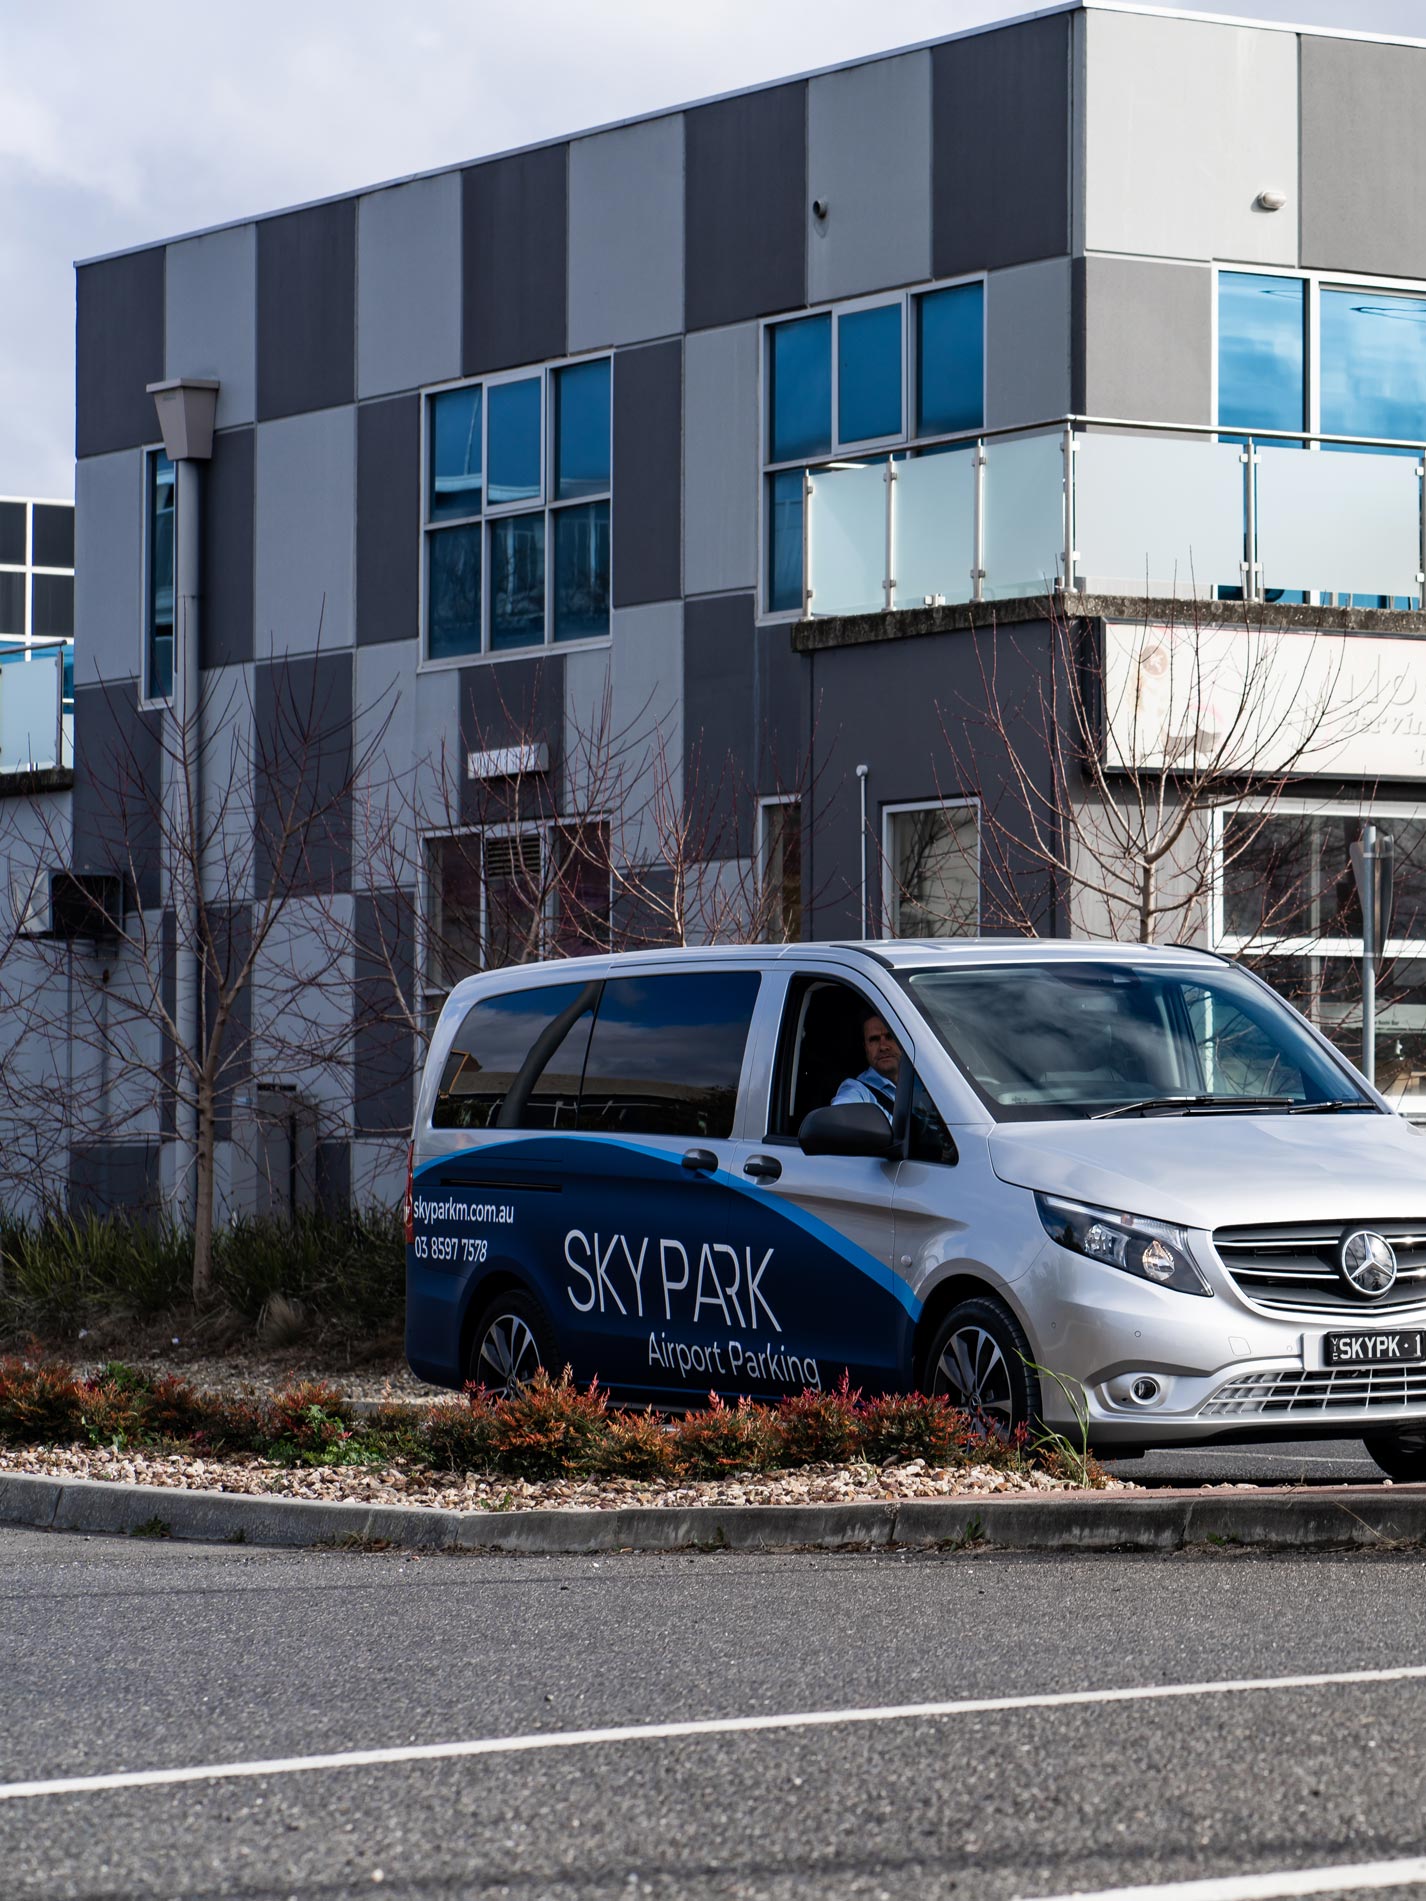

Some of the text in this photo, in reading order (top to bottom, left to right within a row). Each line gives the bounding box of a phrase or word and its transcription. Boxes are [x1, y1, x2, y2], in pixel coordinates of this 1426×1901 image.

[413, 1195, 515, 1225] skyparkm.com.au
[414, 1235, 488, 1263] 03 8597 7578
[648, 1330, 822, 1393] Airport Parking
[1340, 1335, 1400, 1359] SKYPK
